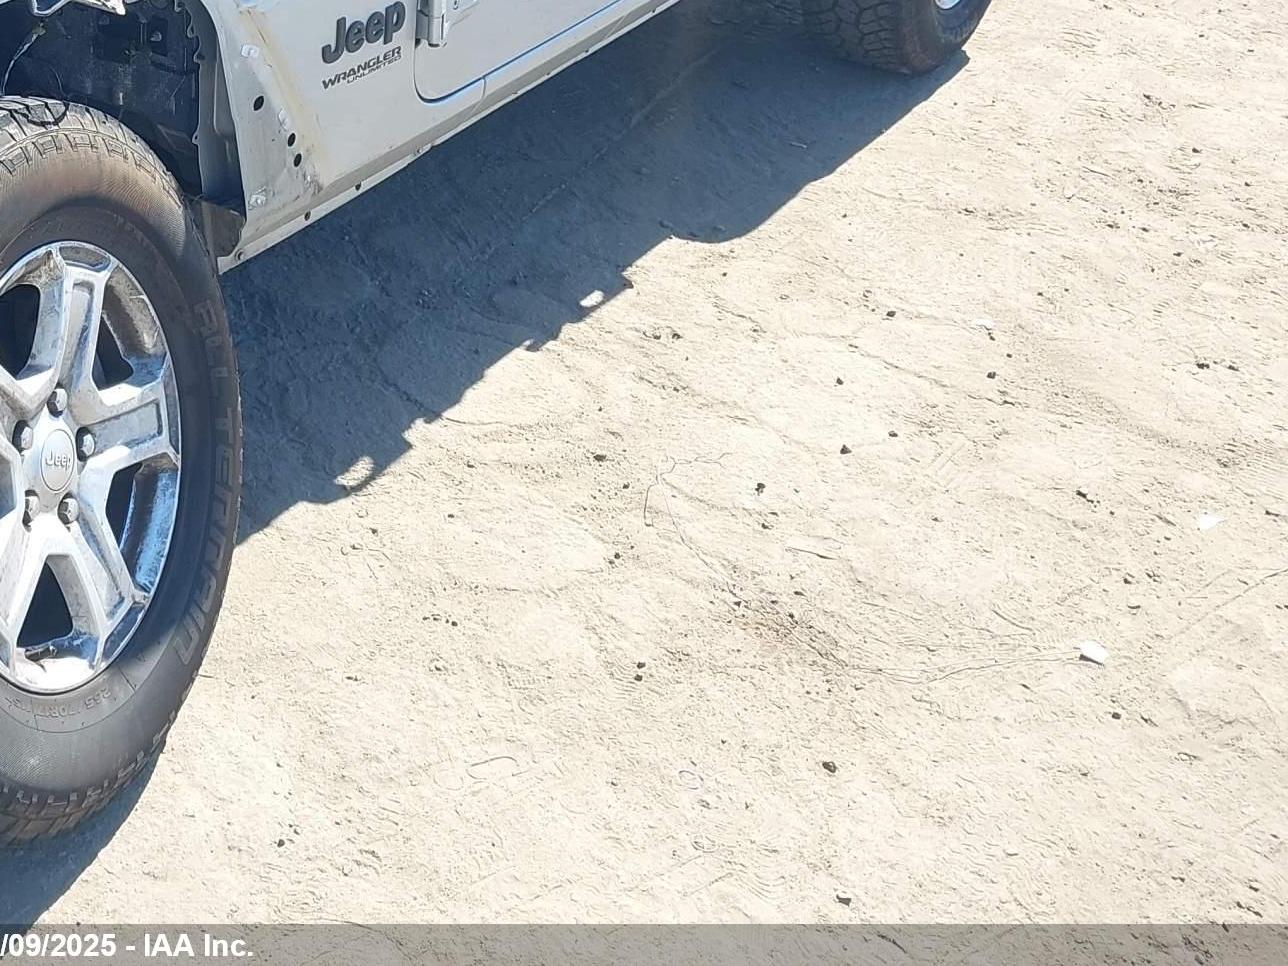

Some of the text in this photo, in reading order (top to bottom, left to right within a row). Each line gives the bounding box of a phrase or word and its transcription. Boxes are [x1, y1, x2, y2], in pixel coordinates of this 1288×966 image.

[321, 0, 407, 65] Jeep
[321, 45, 402, 90] WRANGLER
[346, 54, 402, 84] UNLIMITED
[45, 449, 72, 472] Jeep
